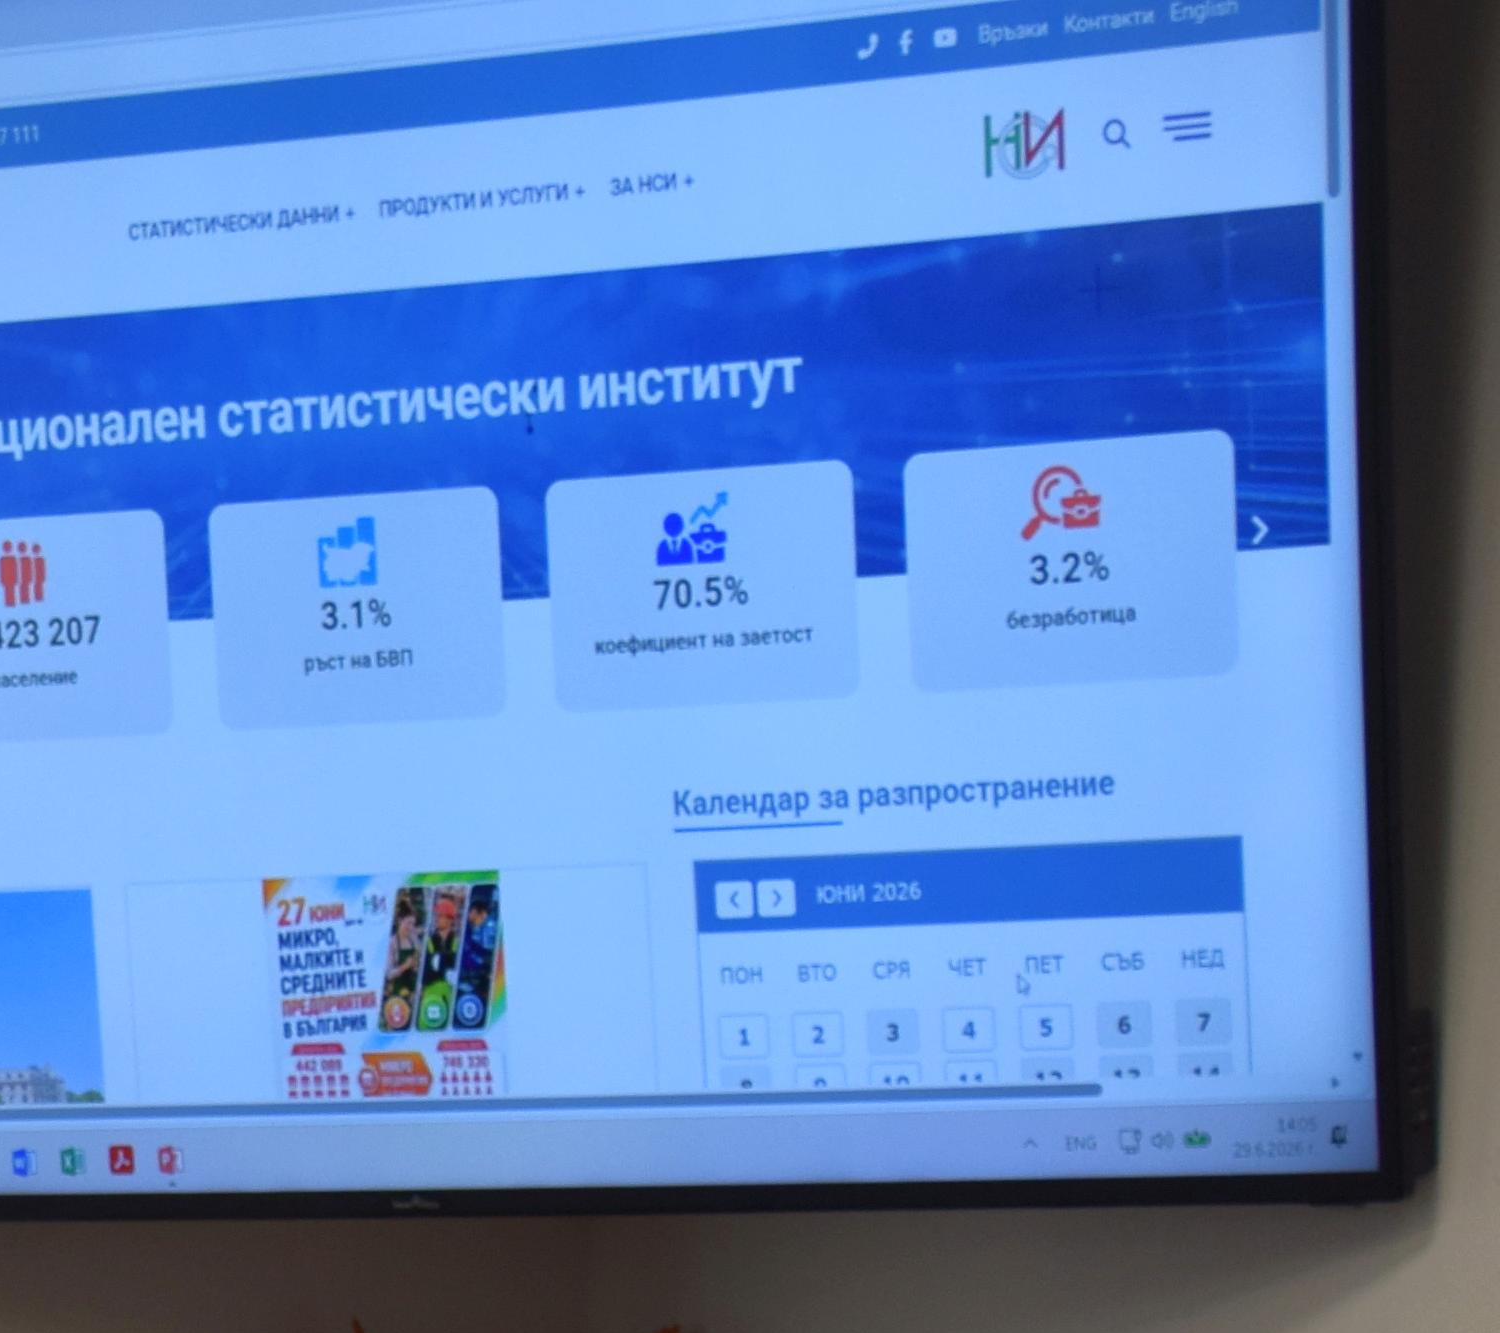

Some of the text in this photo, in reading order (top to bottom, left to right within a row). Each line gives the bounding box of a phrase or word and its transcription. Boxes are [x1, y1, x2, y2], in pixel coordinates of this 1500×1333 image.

[1064, 8, 1155, 35] Контакти
[1169, 0, 1238, 24] English
[979, 20, 1049, 46] Връзки
[13, 124, 40, 144] 111
[610, 172, 677, 197] ЗА НСИ
[379, 183, 570, 220] ПРОДУКТИ И УСЛУГИ
[128, 204, 341, 241] СТАТИСТИЧЕСКИ ДАННИ
[218, 376, 565, 439] статистически
[579, 354, 803, 410] институт
[1030, 550, 1111, 586] 3.2%
[653, 575, 749, 610] 70.5%
[321, 598, 392, 631] 3.1%
[1007, 604, 1137, 631] безработица
[49, 615, 101, 646] 207
[595, 626, 814, 659] коефициент на заетост
[304, 648, 414, 675] ръст на БВП
[673, 774, 1116, 822] Календар за разпространение
[816, 881, 922, 904] ЮНИ 2026
[277, 896, 344, 927] 27 ЮНИ
[277, 928, 340, 951] МИКРО,
[280, 949, 350, 972] МАЛКИТЕ
[721, 948, 1226, 985] ПОН ВТО СРЯ ЧЕТ ПЕТ СЪБ НЕД
[281, 969, 367, 995] СРЕДНИТЕ
[283, 1014, 368, 1039] В БЪЛГАРИЯ
[738, 1011, 1211, 1047] 1 2 3 4 5 6 7
[1065, 1135, 1097, 1152] ENG
